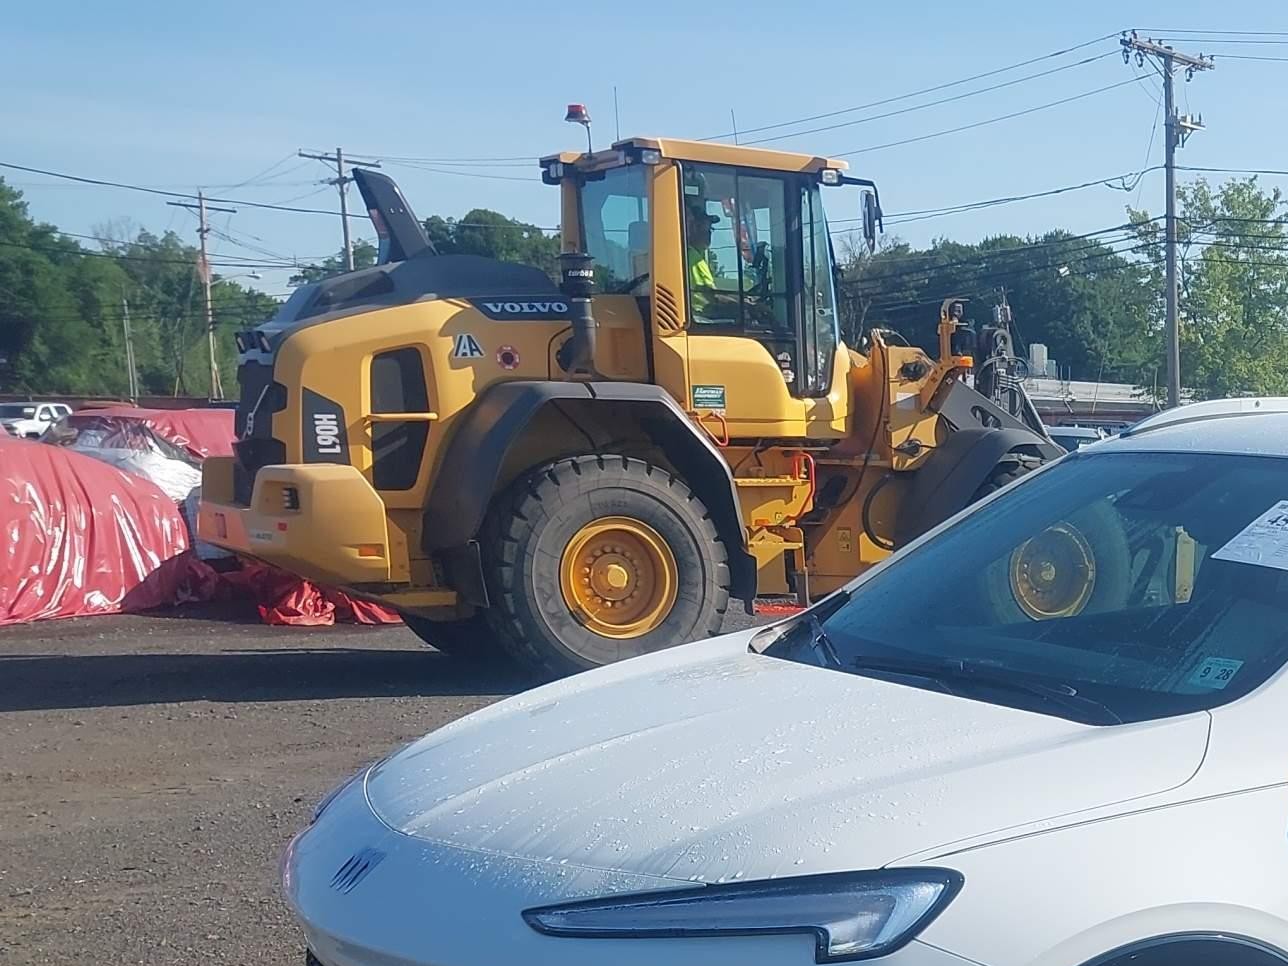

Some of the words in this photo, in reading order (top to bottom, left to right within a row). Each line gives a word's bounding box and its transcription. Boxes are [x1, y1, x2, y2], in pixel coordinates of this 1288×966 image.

[484, 302, 568, 313] VOLVO
[313, 414, 341, 454] L90H
[1200, 667, 1211, 677] 9
[1215, 669, 1233, 680] 28
